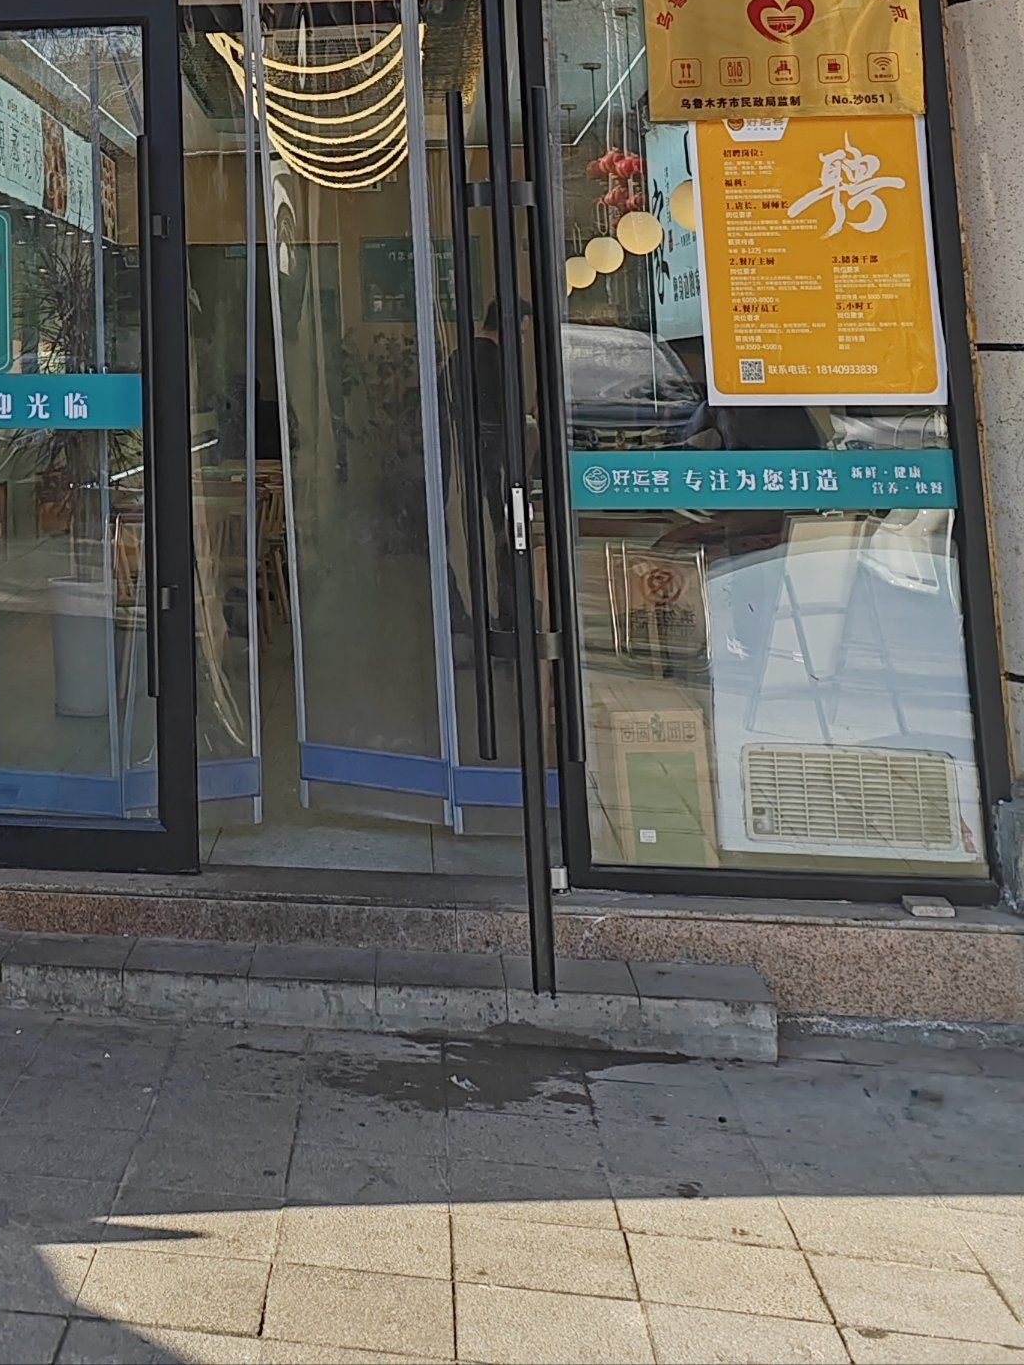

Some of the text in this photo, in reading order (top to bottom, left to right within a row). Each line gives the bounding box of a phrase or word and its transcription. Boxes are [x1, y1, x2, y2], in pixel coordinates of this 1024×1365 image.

[680, 95, 801, 109] 乌鲁木齐市民政局监制
[787, 130, 906, 240] 聘
[612, 470, 669, 485] 好运客
[682, 466, 839, 492] 专注为您打造
